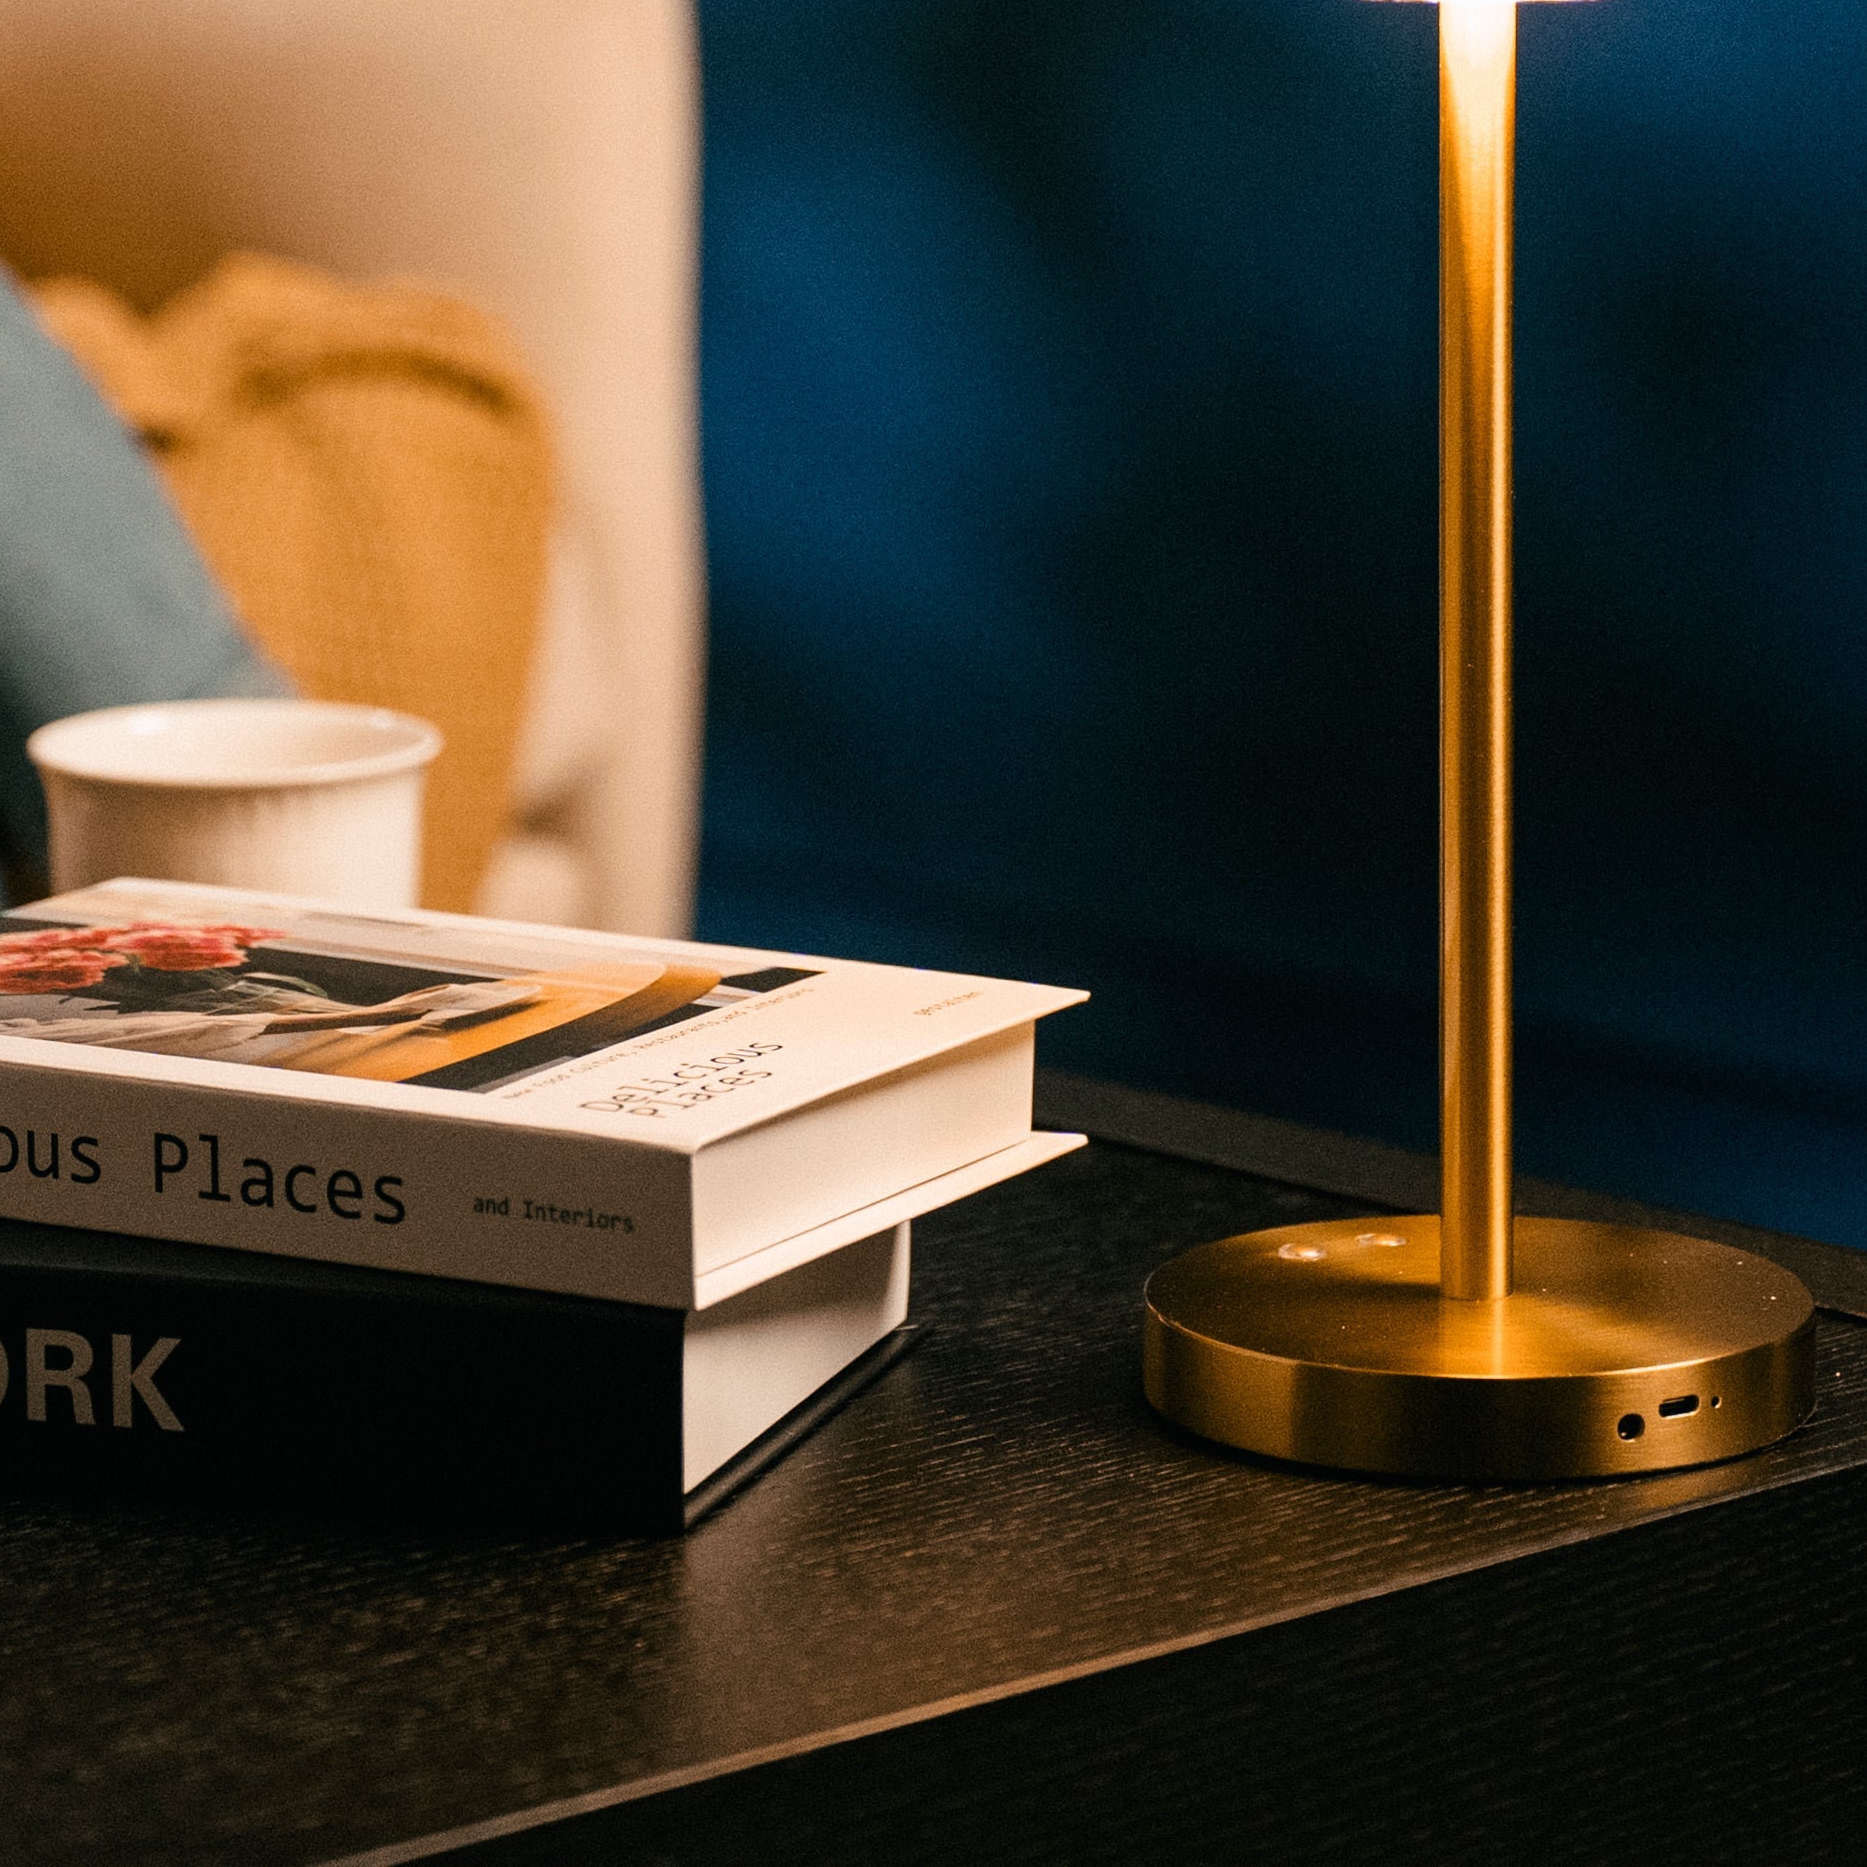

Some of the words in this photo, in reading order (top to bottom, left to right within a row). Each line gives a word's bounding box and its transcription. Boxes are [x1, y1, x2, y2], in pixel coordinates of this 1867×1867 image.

[579, 1041, 783, 1113] Delicious
[627, 1069, 773, 1119] Places
[153, 1133, 406, 1226] Places
[473, 1196, 509, 1216] and
[524, 1199, 634, 1233] Interiors
